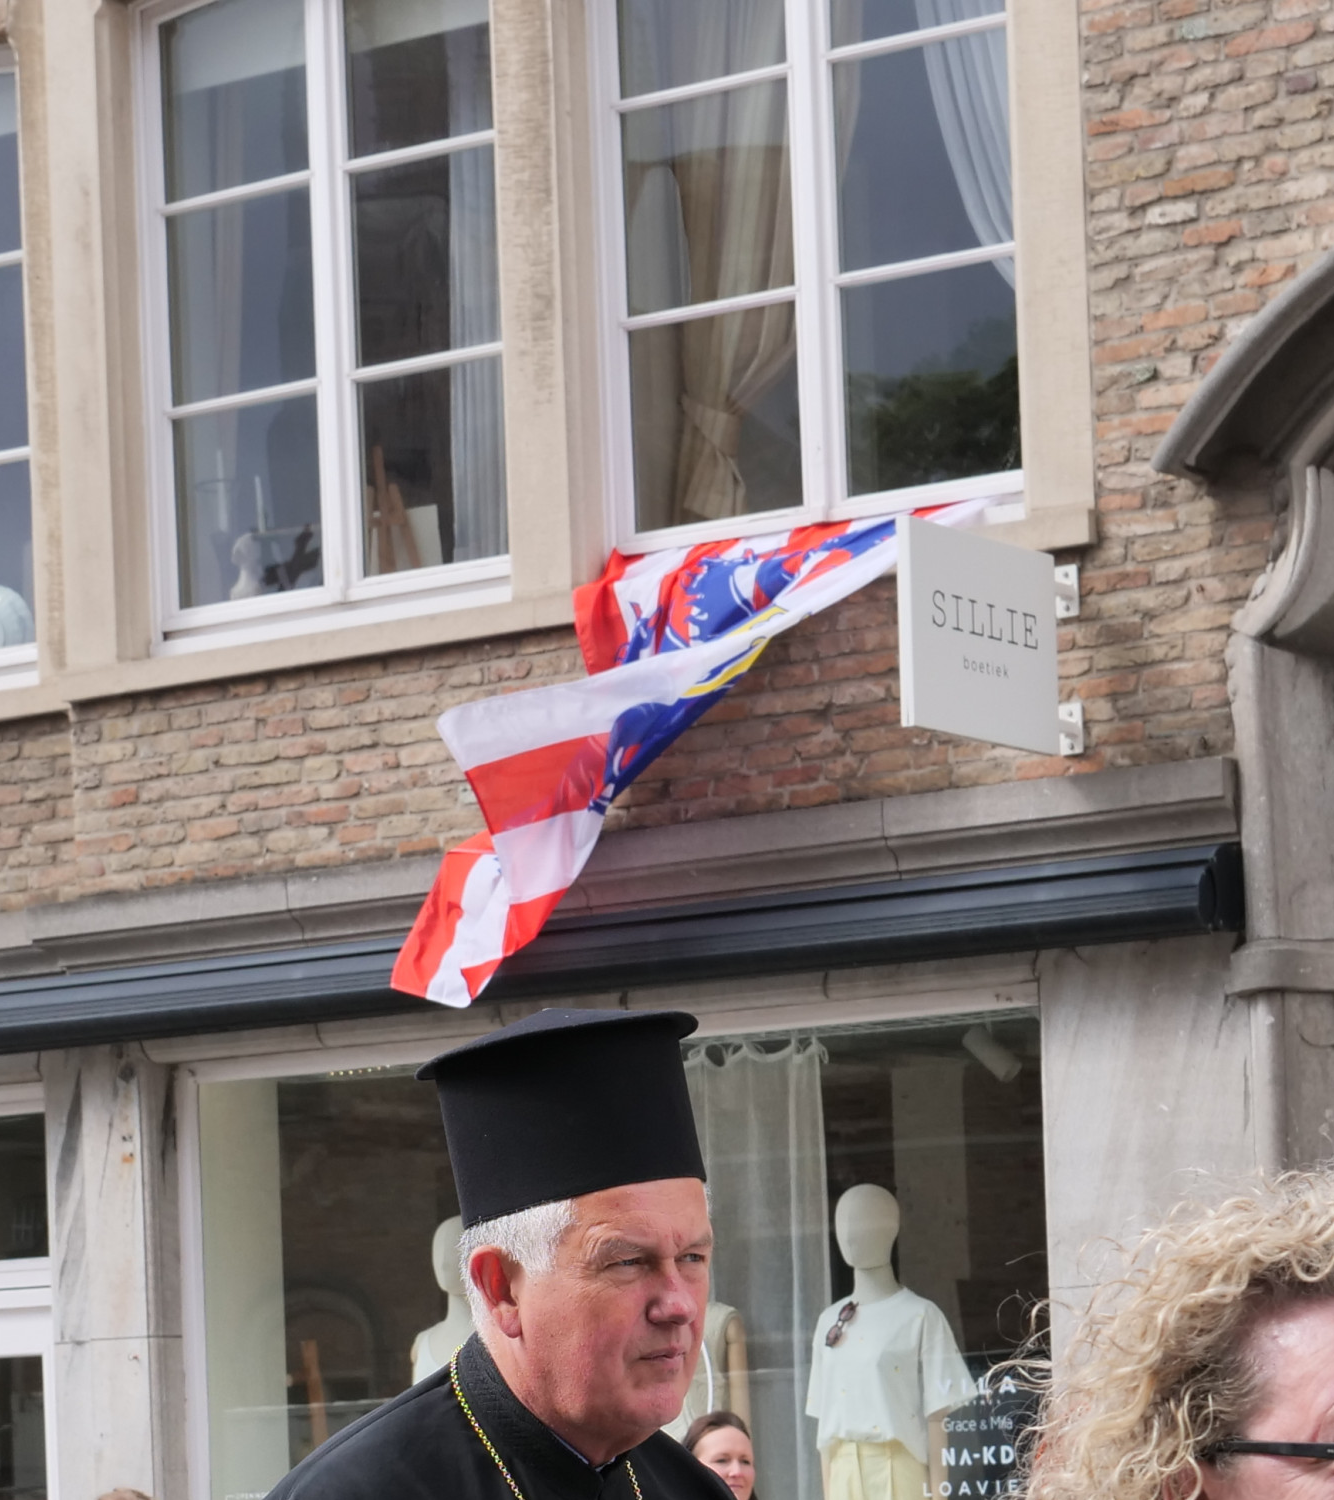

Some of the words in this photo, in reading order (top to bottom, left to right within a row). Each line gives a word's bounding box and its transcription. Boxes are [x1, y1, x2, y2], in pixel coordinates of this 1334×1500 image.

[932, 589, 1039, 650] SILLIE
[963, 655, 1010, 679] boetiek
[937, 1375, 1016, 1395] VILA
[941, 1417, 977, 1432] Grace
[979, 1420, 988, 1430] &
[941, 1445, 1016, 1467] NA-KD
